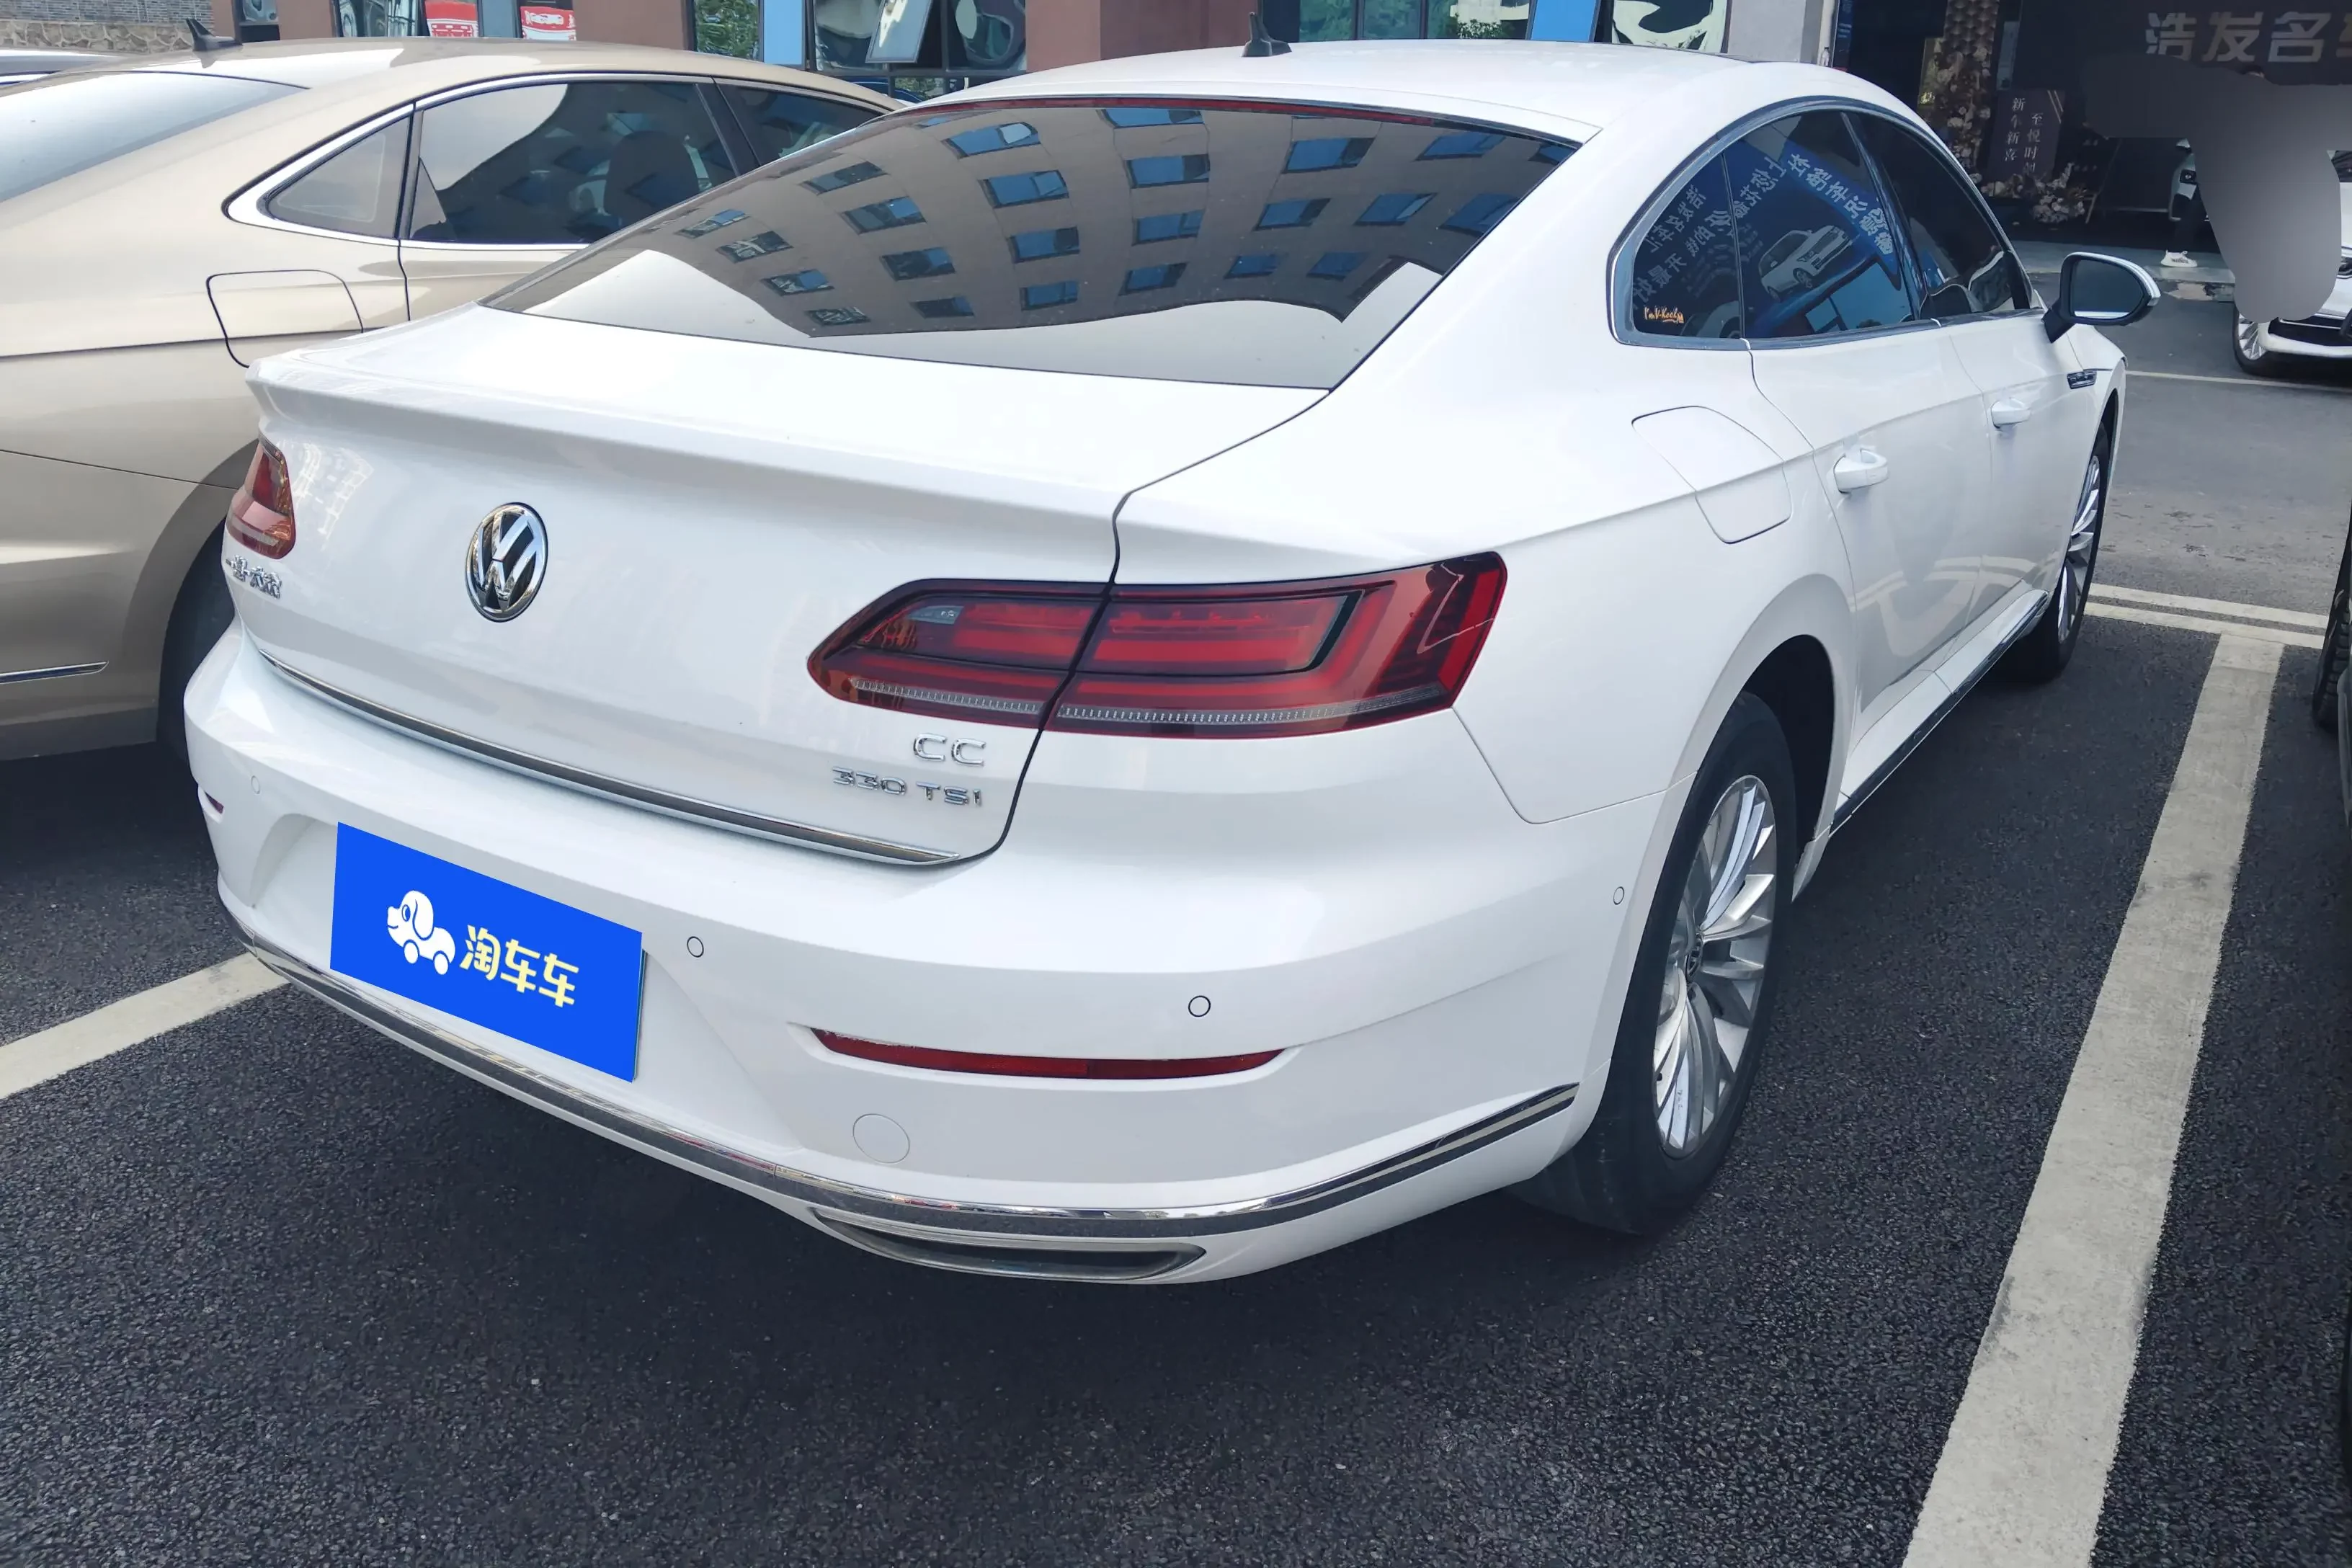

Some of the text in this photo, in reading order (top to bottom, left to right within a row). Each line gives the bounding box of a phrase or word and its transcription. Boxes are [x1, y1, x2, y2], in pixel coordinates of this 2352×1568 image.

[2145, 11, 2352, 63] 浩发名
[913, 732, 986, 767] CC
[832, 766, 906, 796] 330
